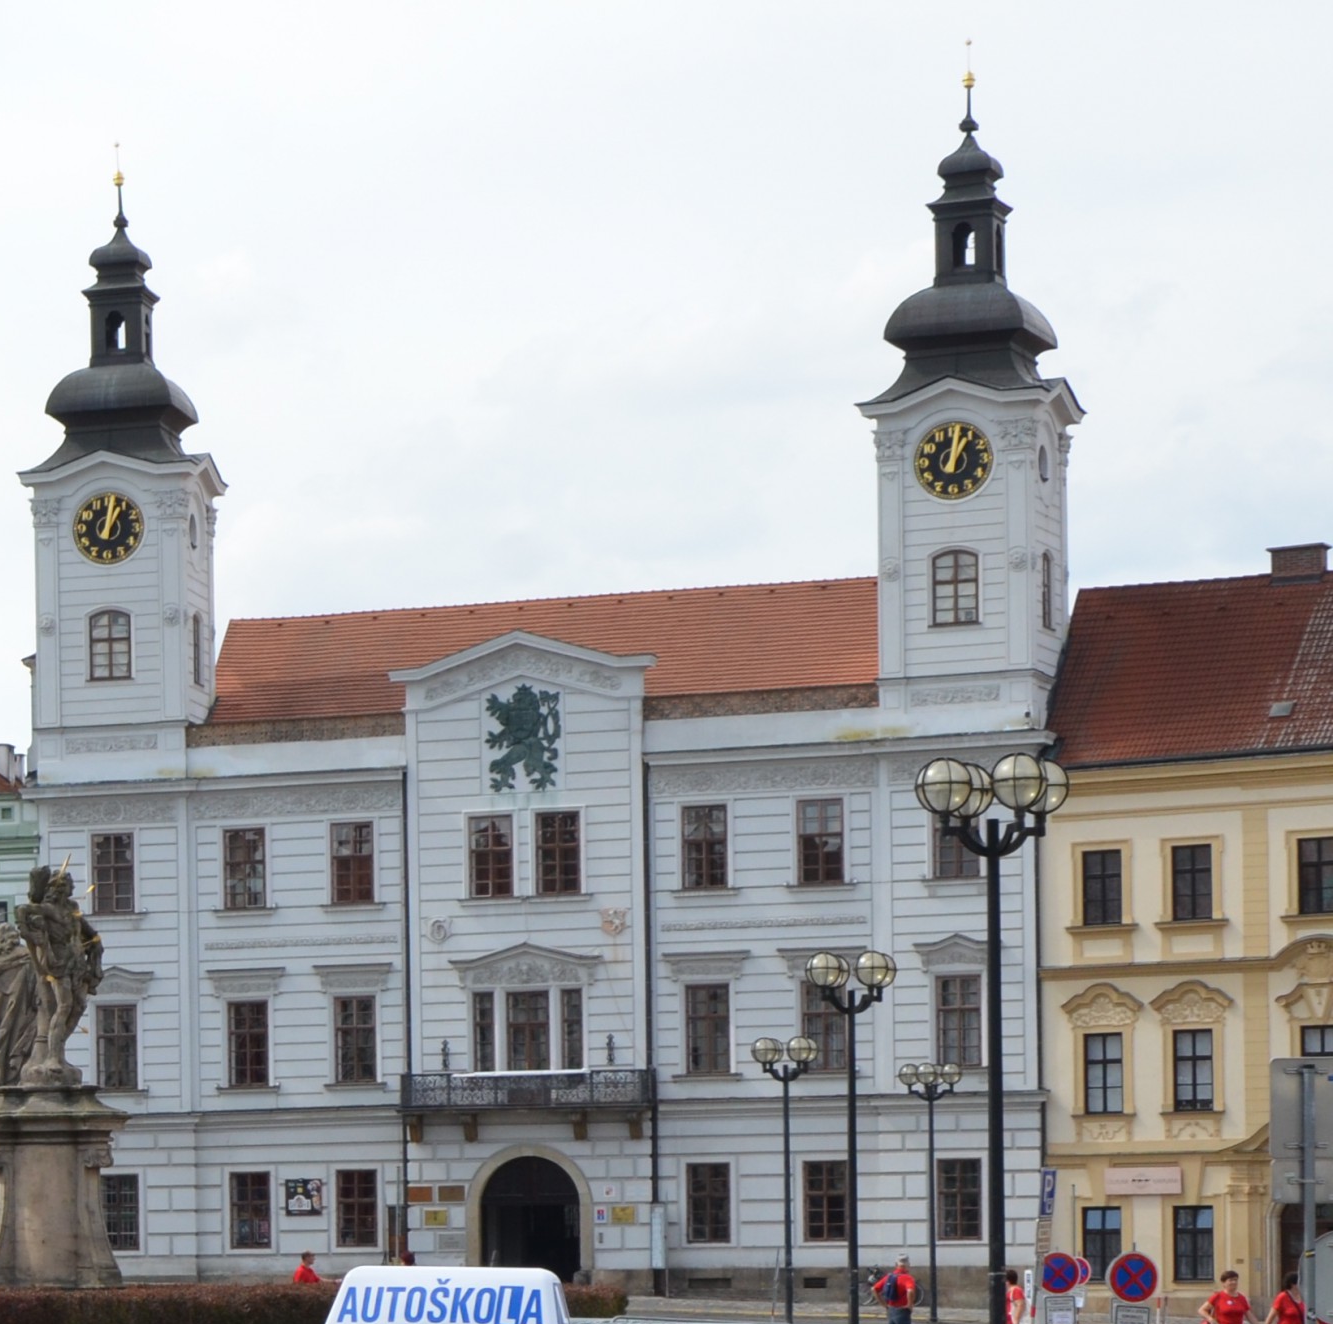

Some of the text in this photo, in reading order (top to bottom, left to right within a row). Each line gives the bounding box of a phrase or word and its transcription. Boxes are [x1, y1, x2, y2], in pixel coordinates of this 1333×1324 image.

[935, 431, 944, 442] 11
[968, 430, 973, 440] 1
[924, 443, 936, 454] 10
[976, 440, 986, 449] 2
[980, 453, 988, 463] 3
[920, 458, 929, 468] 9
[924, 472, 933, 482] 8
[975, 467, 983, 478] 4
[934, 482, 944, 491] 7
[948, 484, 958, 494] 6
[964, 480, 973, 489] 5
[93, 500, 100, 510] 11
[122, 501, 126, 510] 1
[82, 511, 93, 520] 10
[129, 510, 138, 519] 2
[78, 524, 86, 533] 9
[132, 523, 139, 532] 3
[81, 537, 90, 546] 8
[126, 536, 134, 545] 4
[90, 547, 98, 556] 7
[103, 550, 112, 559] 6
[117, 547, 124, 556] 5
